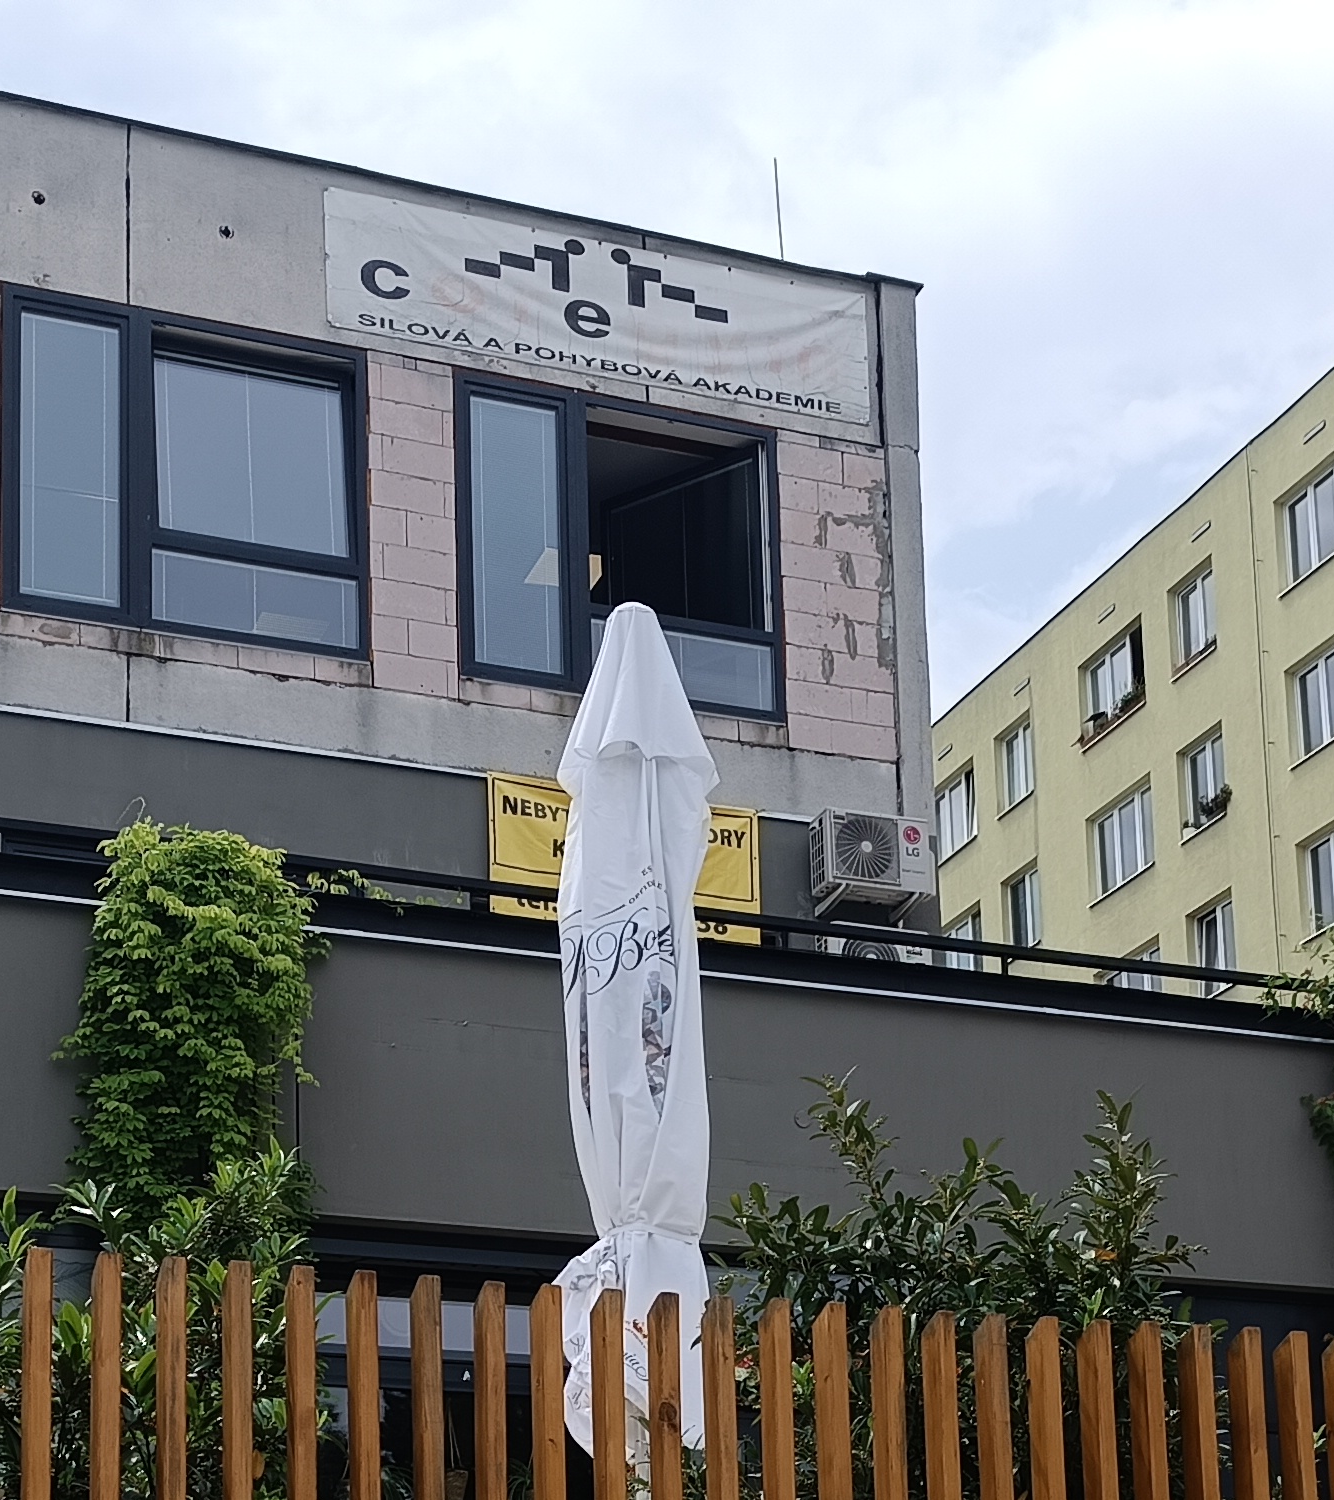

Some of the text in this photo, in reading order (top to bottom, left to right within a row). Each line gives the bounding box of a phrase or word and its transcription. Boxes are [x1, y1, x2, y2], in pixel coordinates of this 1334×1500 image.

[357, 313, 843, 415] SILOVÁ A POHYBOVÁ AKADEMIE
[905, 846, 920, 857] LG
